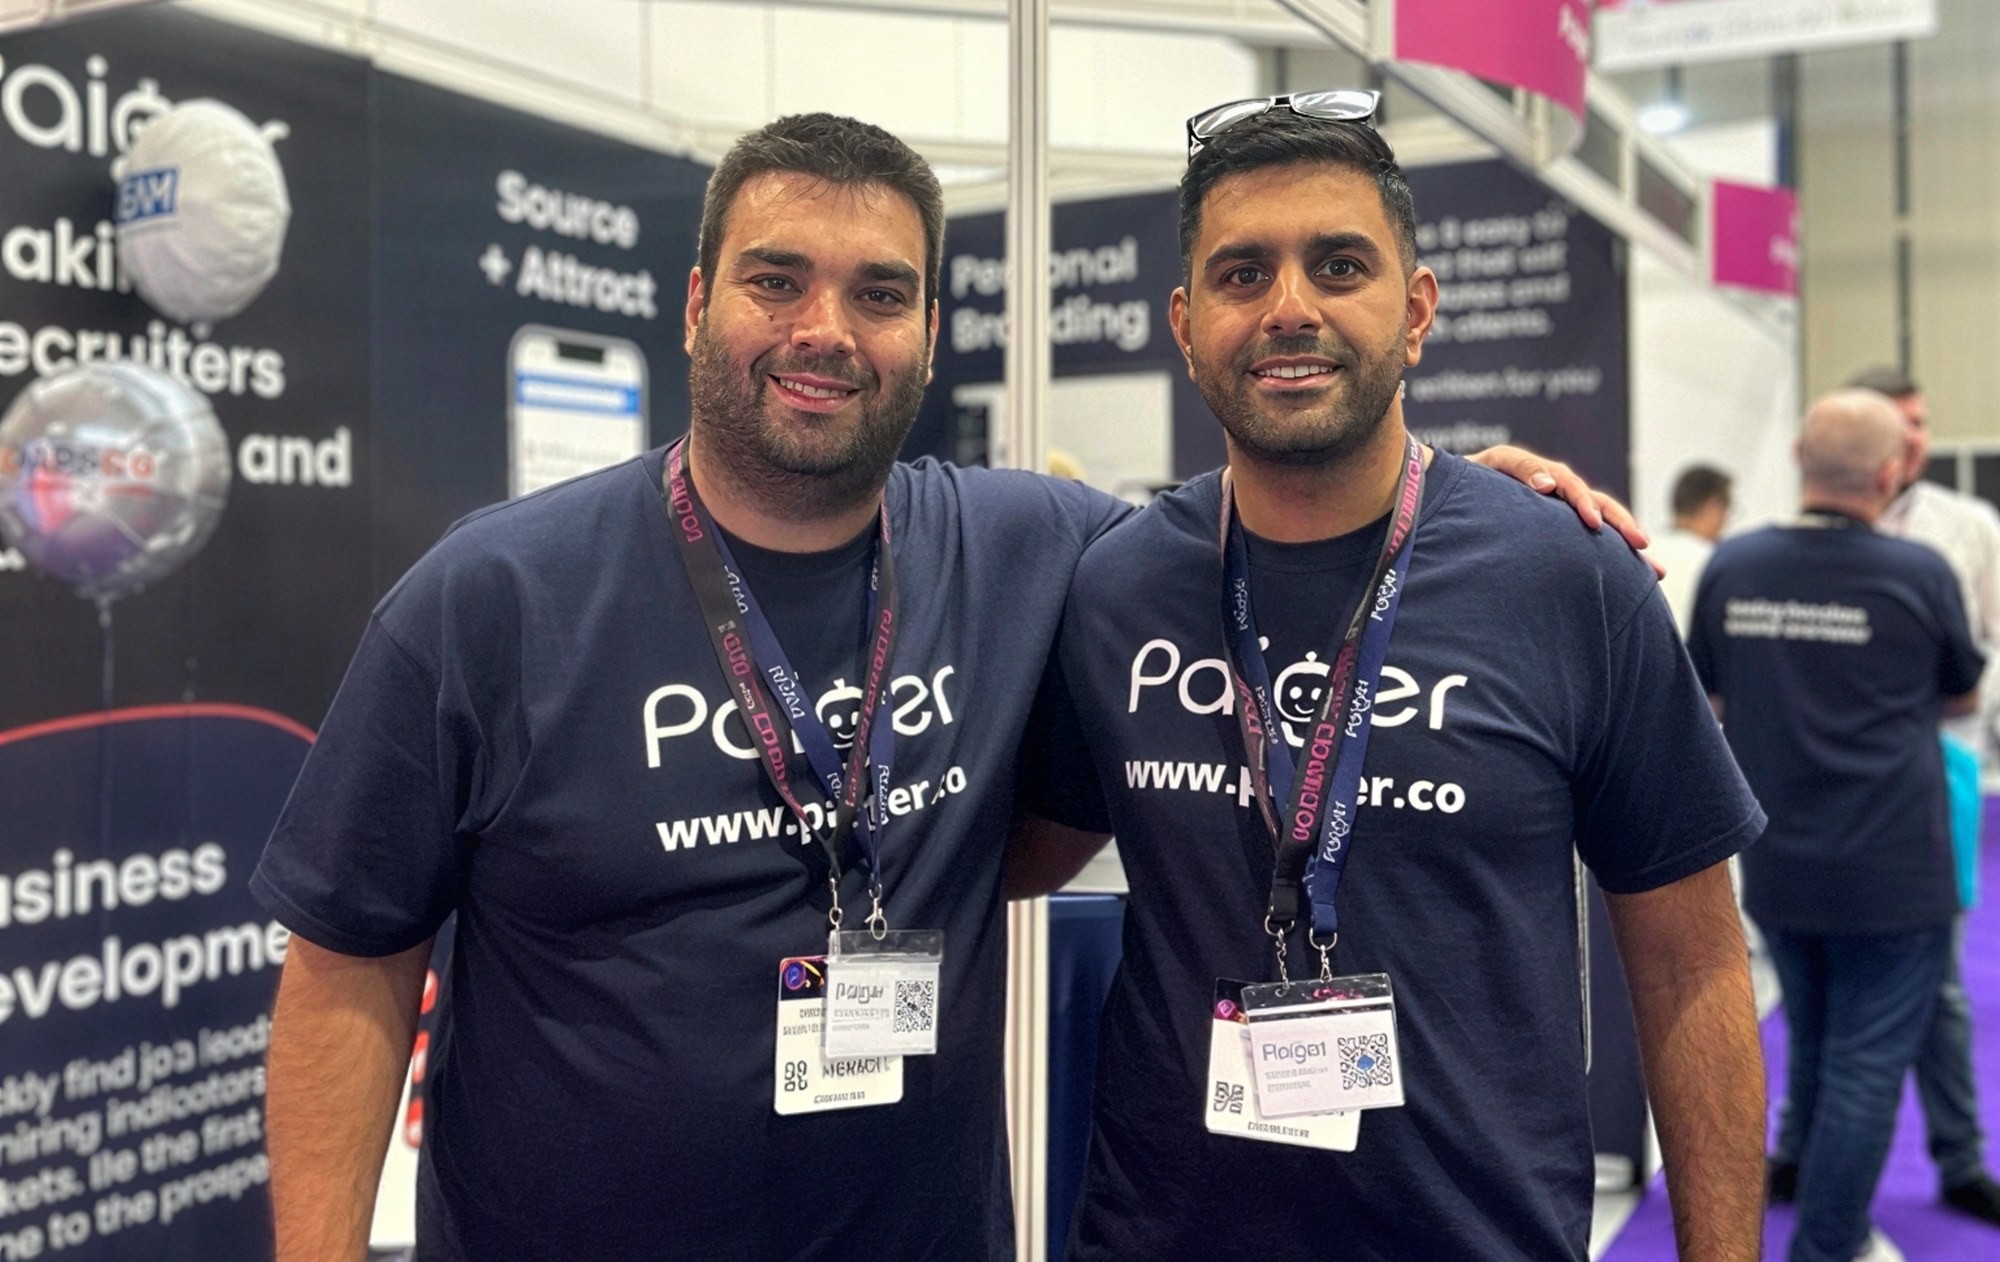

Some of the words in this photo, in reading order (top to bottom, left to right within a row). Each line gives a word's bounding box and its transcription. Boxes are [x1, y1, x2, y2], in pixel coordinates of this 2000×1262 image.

[496, 169, 639, 249] Source
[516, 244, 658, 319] Attract
[951, 236, 1138, 299] Penal
[951, 295, 1149, 352] Brding
[238, 425, 353, 488] and
[643, 664, 955, 770] Pager
[1128, 635, 1469, 748] Pager
[1125, 760, 1467, 814] www.per.co
[198, 1013, 273, 1067] lead
[47, 1209, 91, 1250] to
